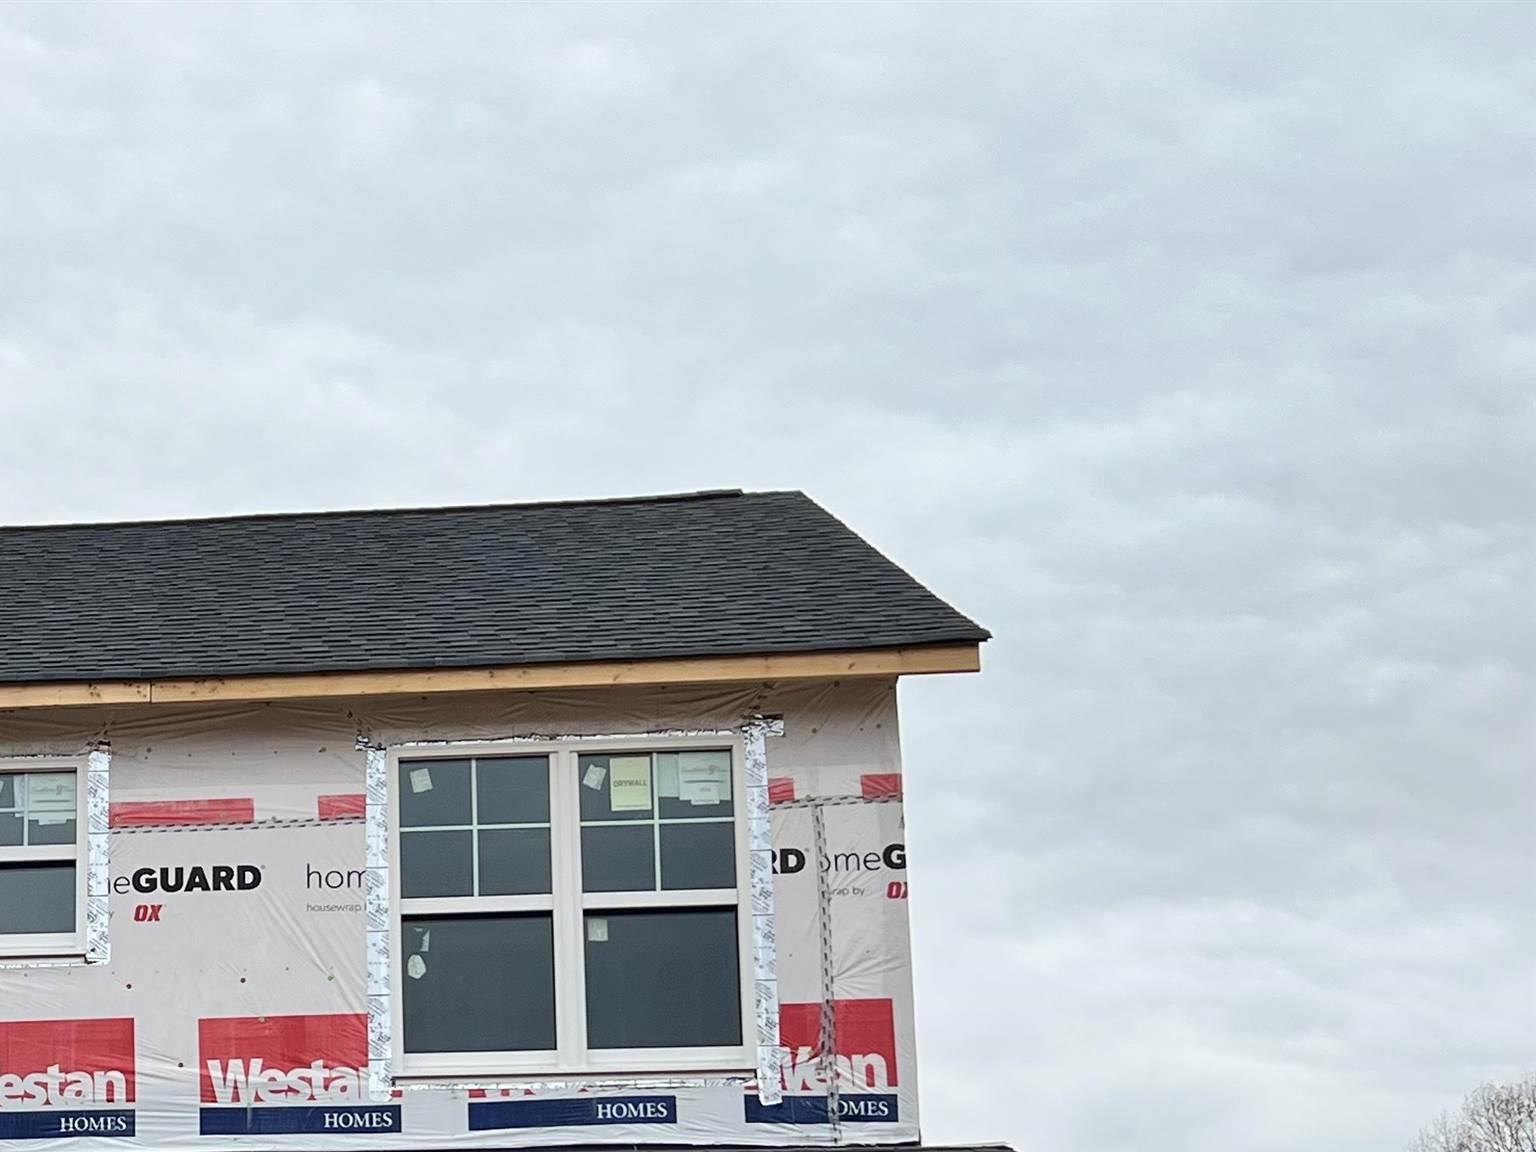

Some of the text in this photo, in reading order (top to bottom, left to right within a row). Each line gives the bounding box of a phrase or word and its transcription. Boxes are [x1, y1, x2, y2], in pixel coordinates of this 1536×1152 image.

[614, 779, 648, 788] DRYWALL
[107, 864, 262, 896] eGUARD
[133, 904, 163, 923] OX
[323, 1110, 393, 1131] HOMES
[596, 1100, 668, 1121] HOMES
[59, 1115, 126, 1132] HOMES
